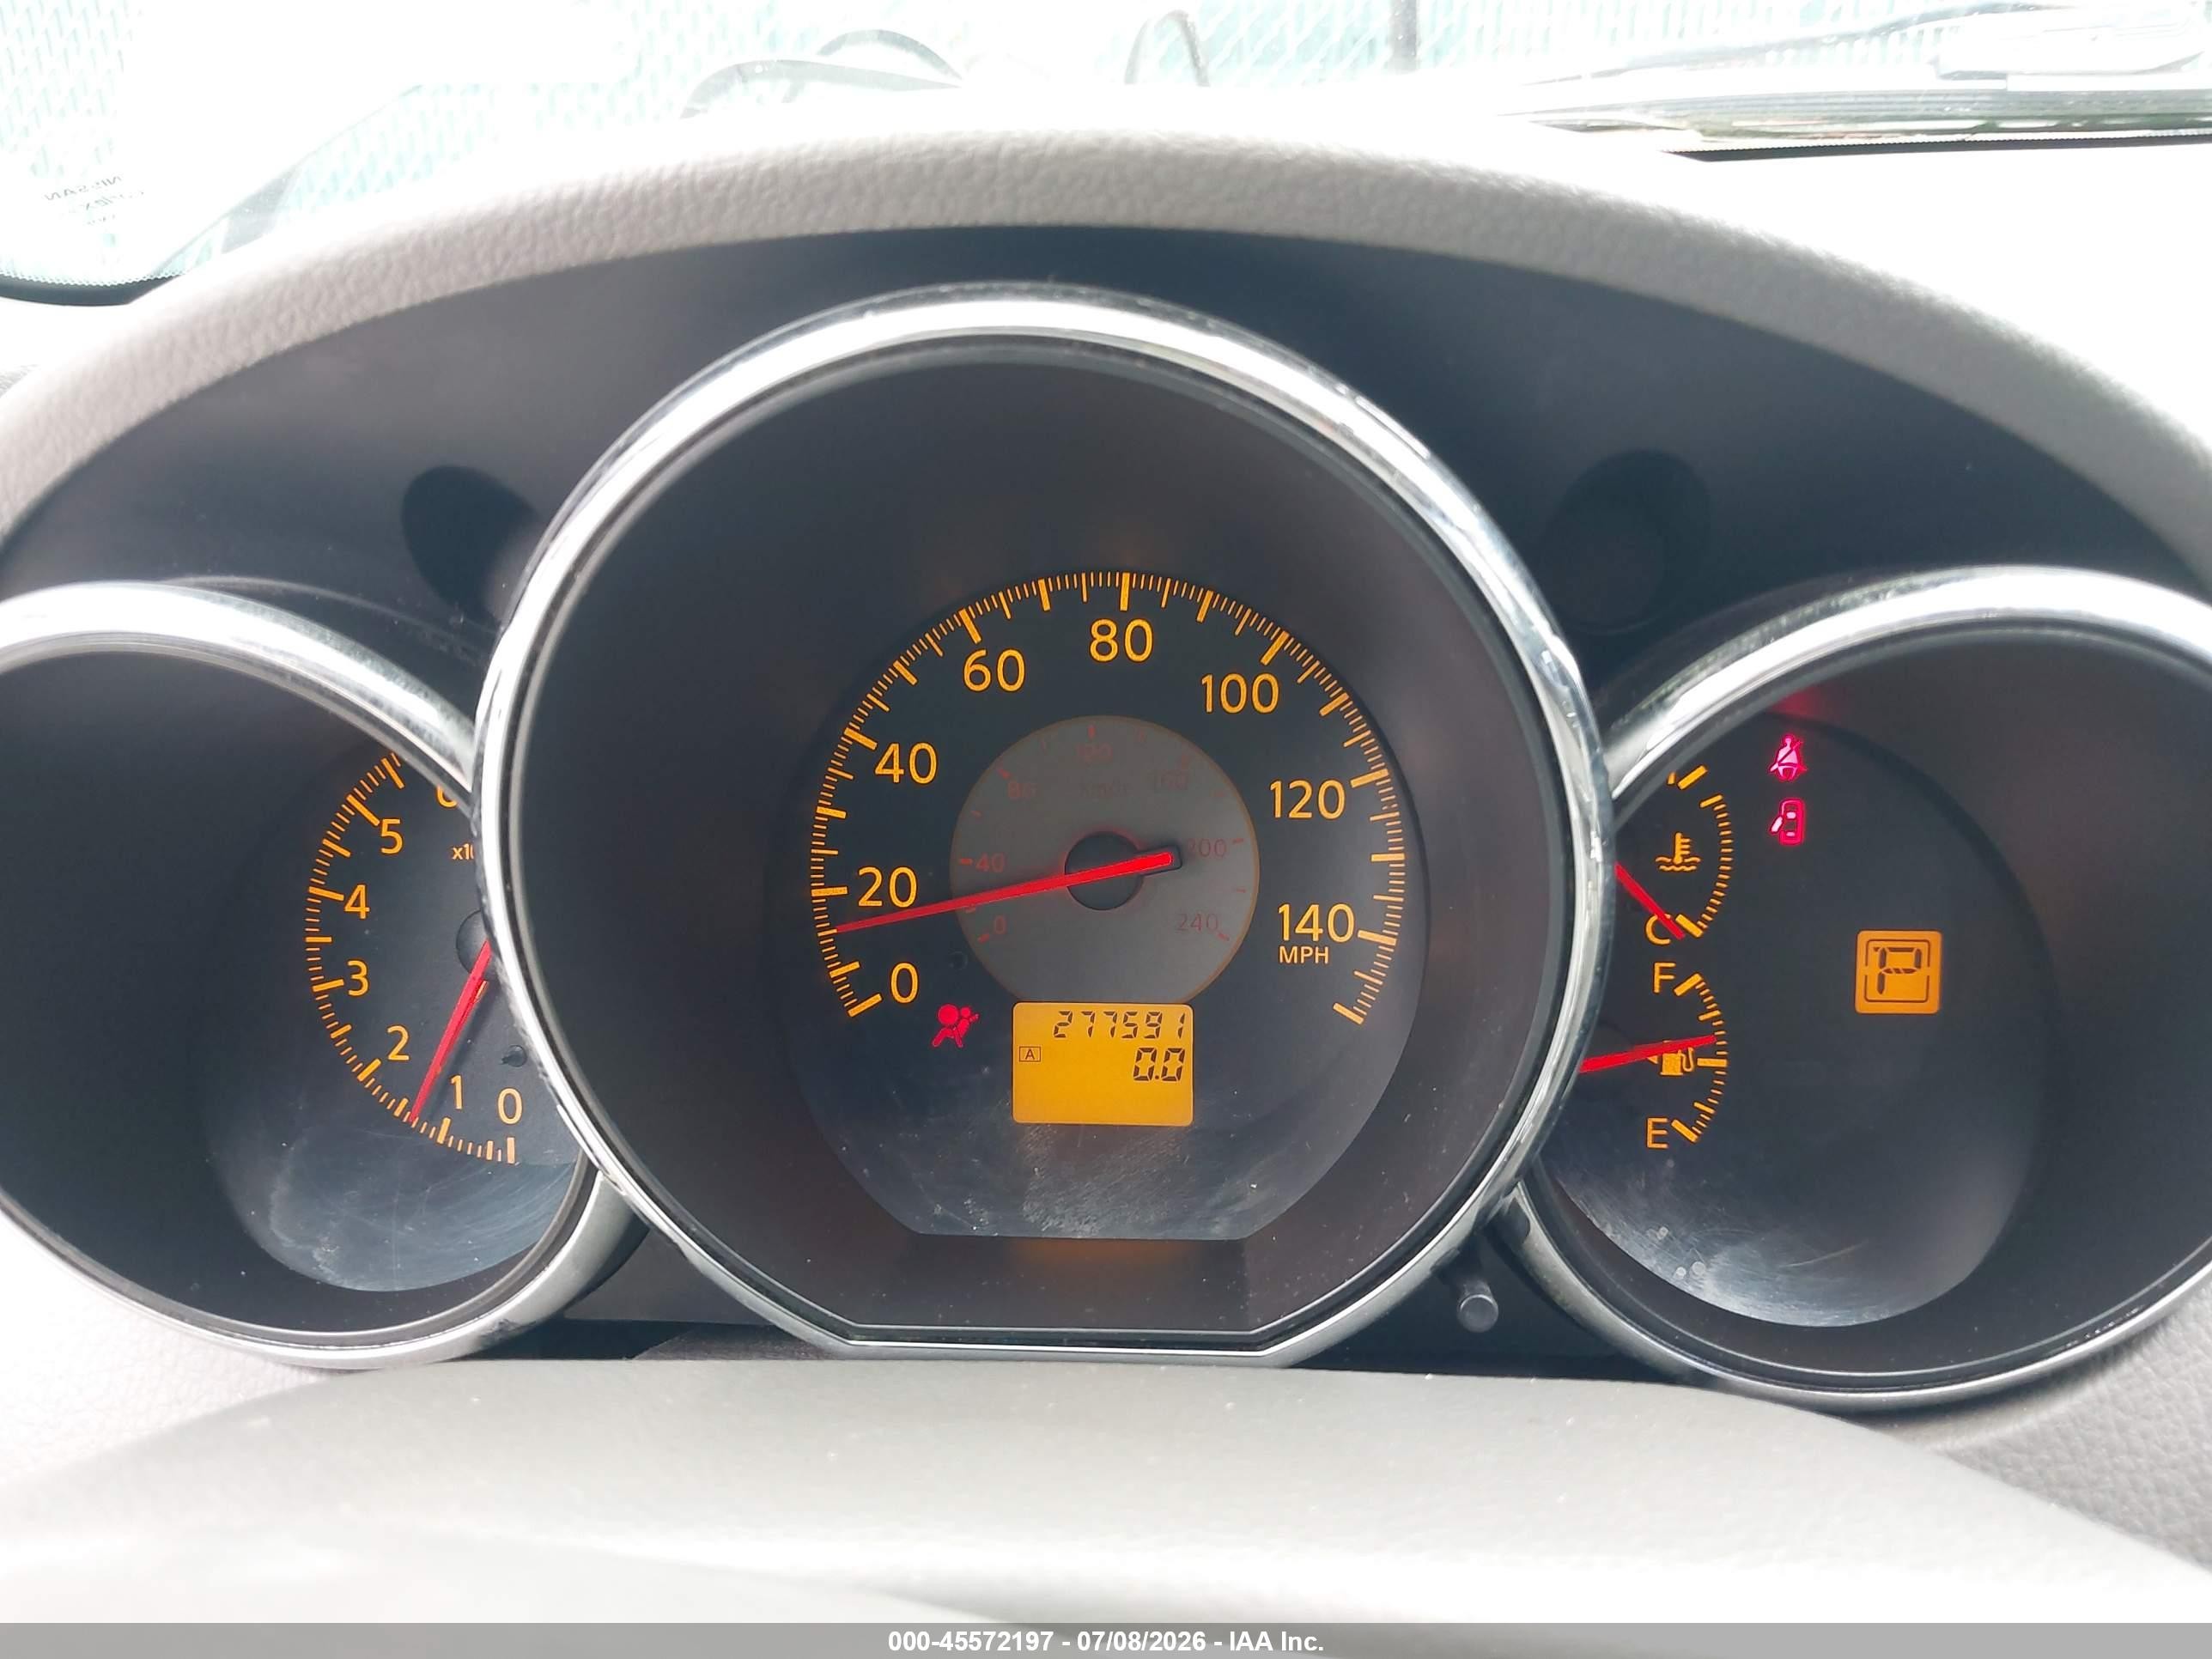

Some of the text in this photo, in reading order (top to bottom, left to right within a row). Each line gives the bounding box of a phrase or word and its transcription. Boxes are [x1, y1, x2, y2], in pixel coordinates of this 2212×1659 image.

[1090, 619, 1153, 662] 80
[963, 648, 1026, 692] 60
[1201, 673, 1279, 714] 100
[874, 742, 938, 784] 40
[1270, 779, 1346, 819] 120
[380, 818, 404, 854] 5
[1186, 837, 1228, 859] 200
[975, 854, 1006, 872] 40
[344, 884, 370, 920] 4
[858, 866, 918, 908] 20
[994, 915, 1007, 934] 0
[1177, 913, 1220, 933] 240
[1278, 902, 1356, 944] 140
[1645, 914, 1671, 945] C
[1279, 945, 1329, 964] MPH
[1873, 947, 1922, 994] P
[347, 959, 370, 997] 3
[890, 962, 919, 1004] 0
[1653, 963, 1676, 994] F
[387, 1024, 410, 1061] 2
[1053, 1011, 1186, 1039] 277591
[1024, 1048, 1036, 1060] A
[1133, 1047, 1186, 1082] 0.0
[450, 1075, 464, 1109] 1
[497, 1088, 523, 1124] 0
[1646, 1117, 1669, 1149] E
